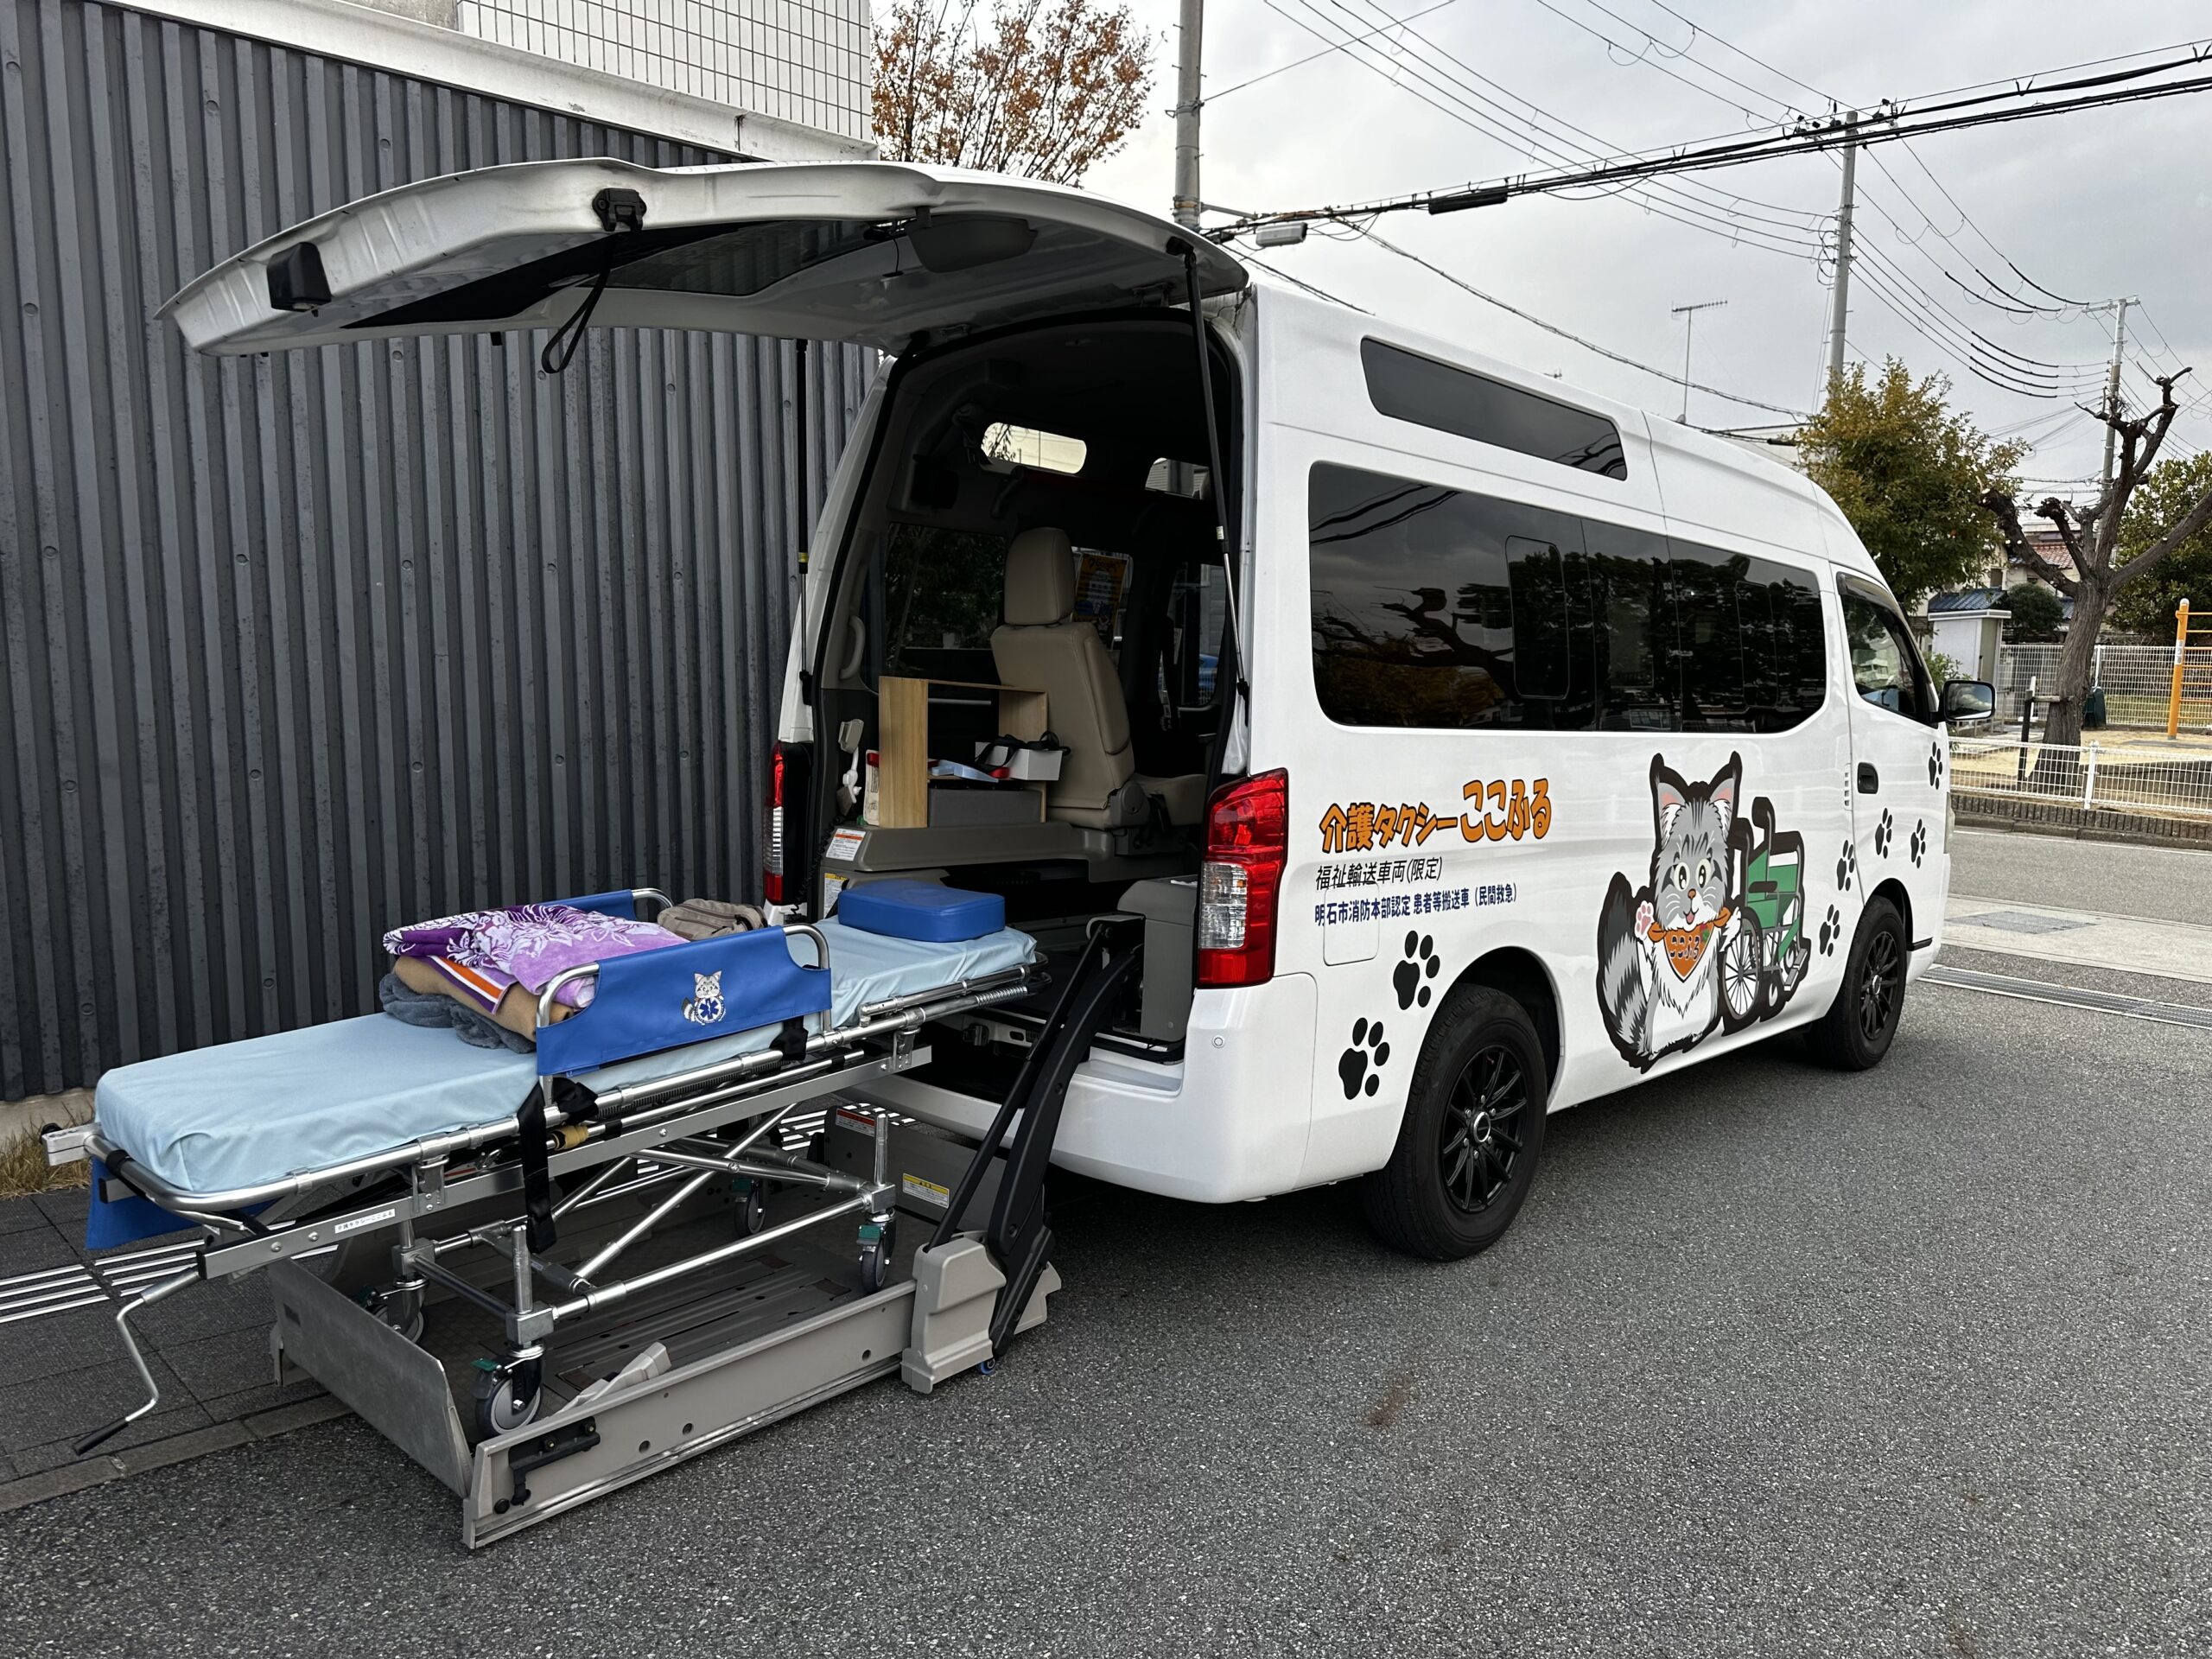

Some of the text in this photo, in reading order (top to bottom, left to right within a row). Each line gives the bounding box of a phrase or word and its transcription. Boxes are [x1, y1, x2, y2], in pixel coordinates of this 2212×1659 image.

[1315, 857, 1443, 891] 福祉輸送車両(限定)
[1315, 894, 1411, 927] 明石市消防本部認定
